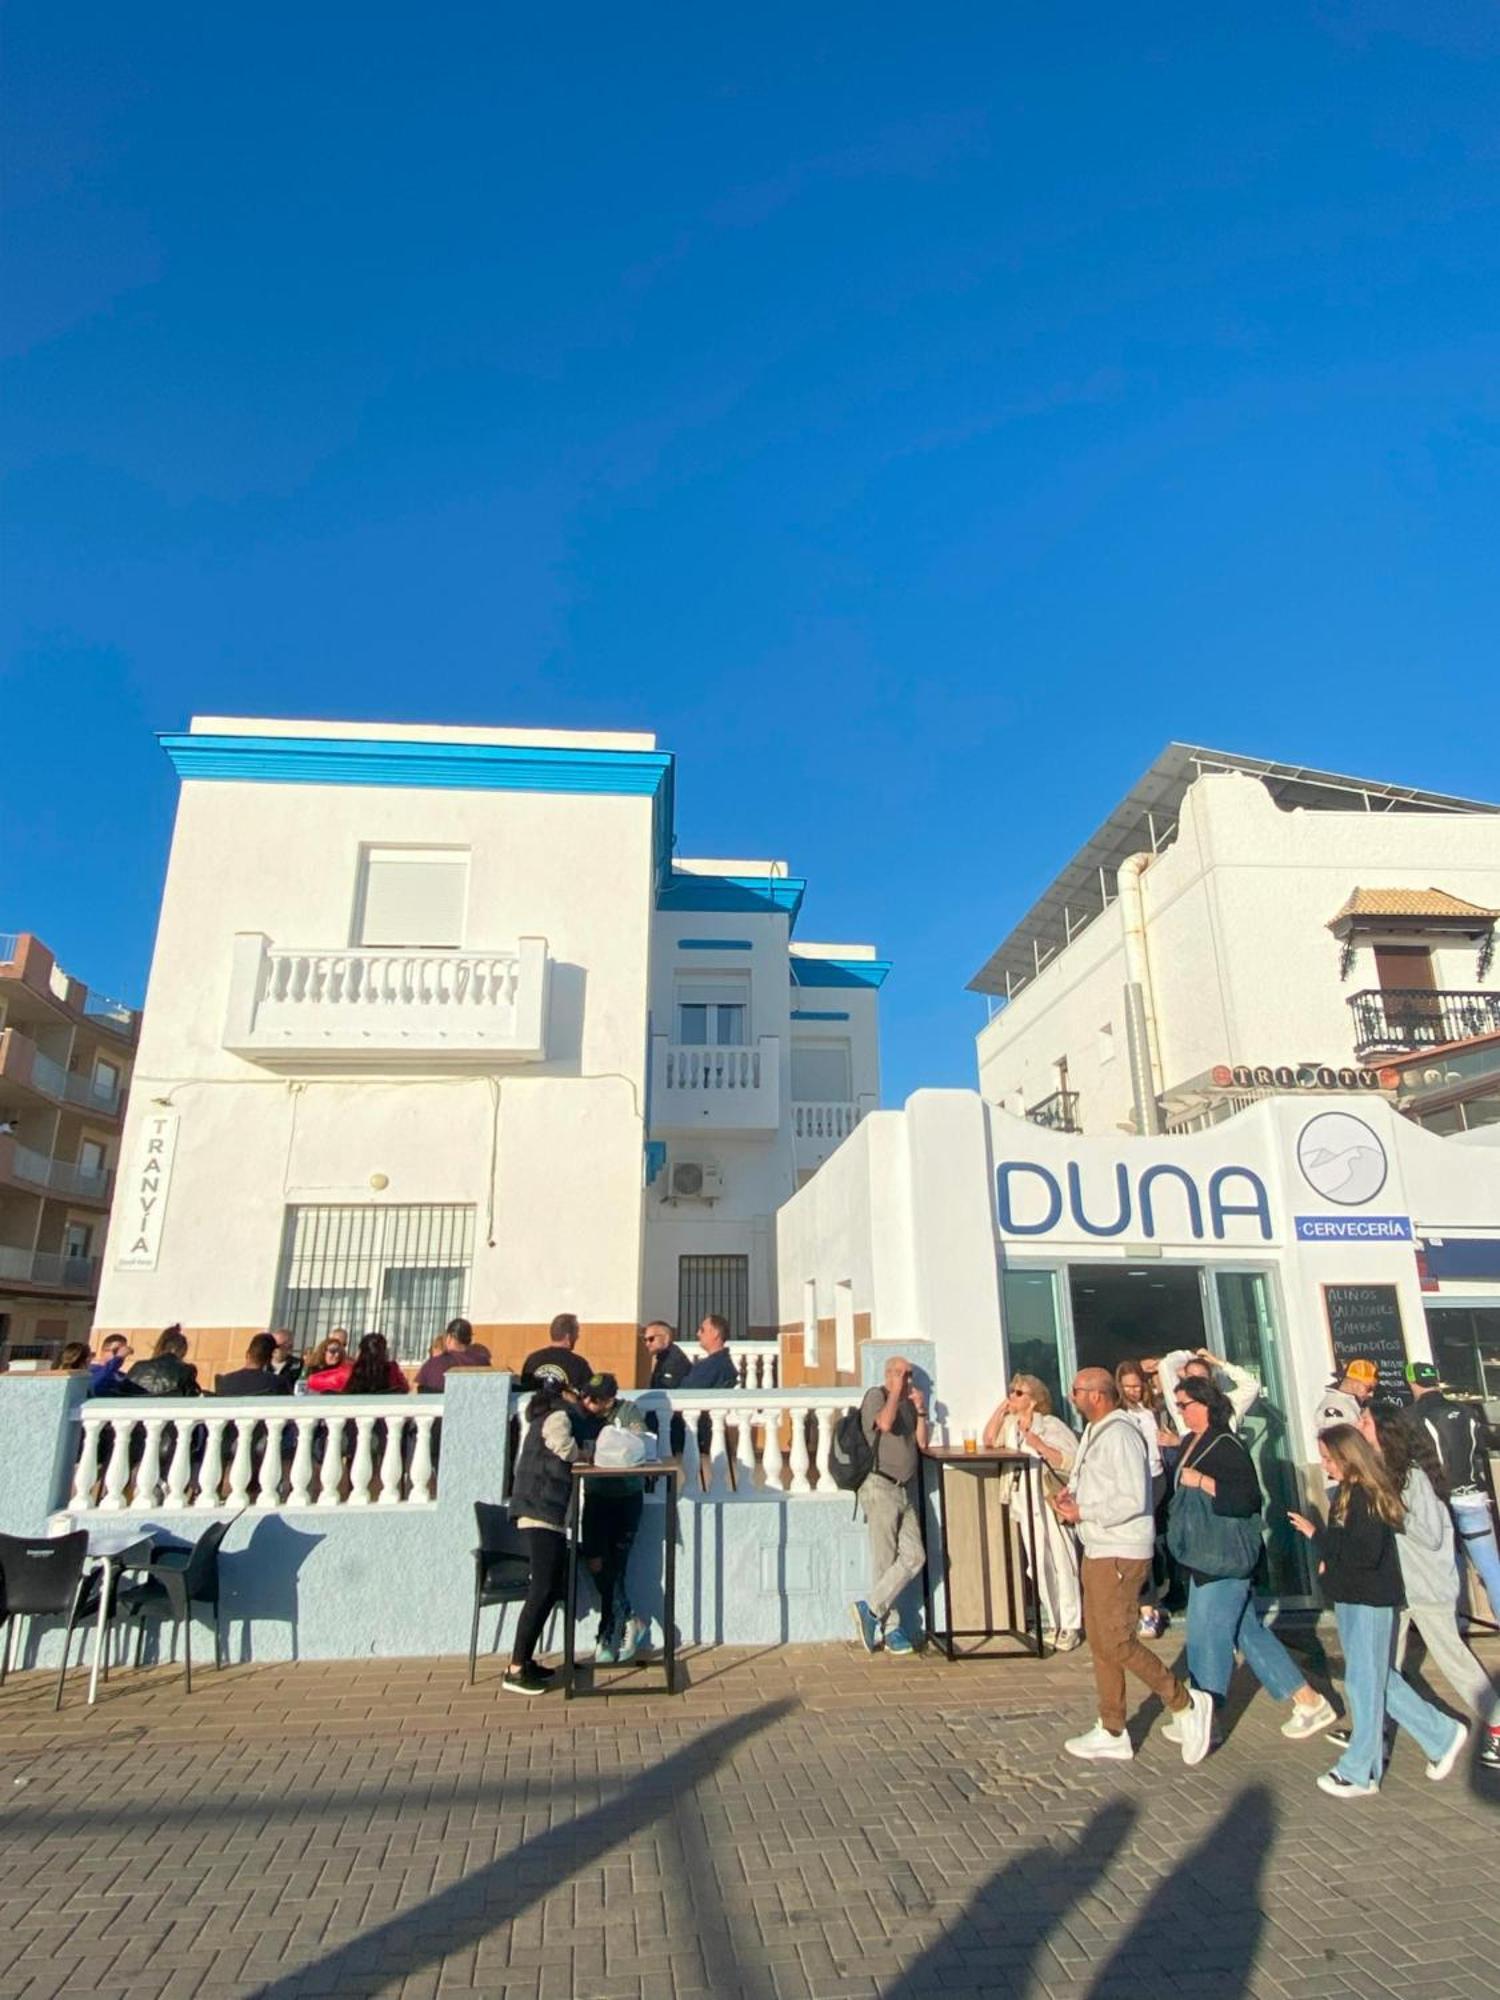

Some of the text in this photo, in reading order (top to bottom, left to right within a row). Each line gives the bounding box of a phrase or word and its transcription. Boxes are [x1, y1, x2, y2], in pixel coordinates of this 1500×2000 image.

[1234, 1067, 1374, 1089] TRIITY
[130, 1119, 167, 1253] TRANVÍA
[996, 1161, 1273, 1240] DUNA
[1302, 1220, 1405, 1237] CERVECERÍA
